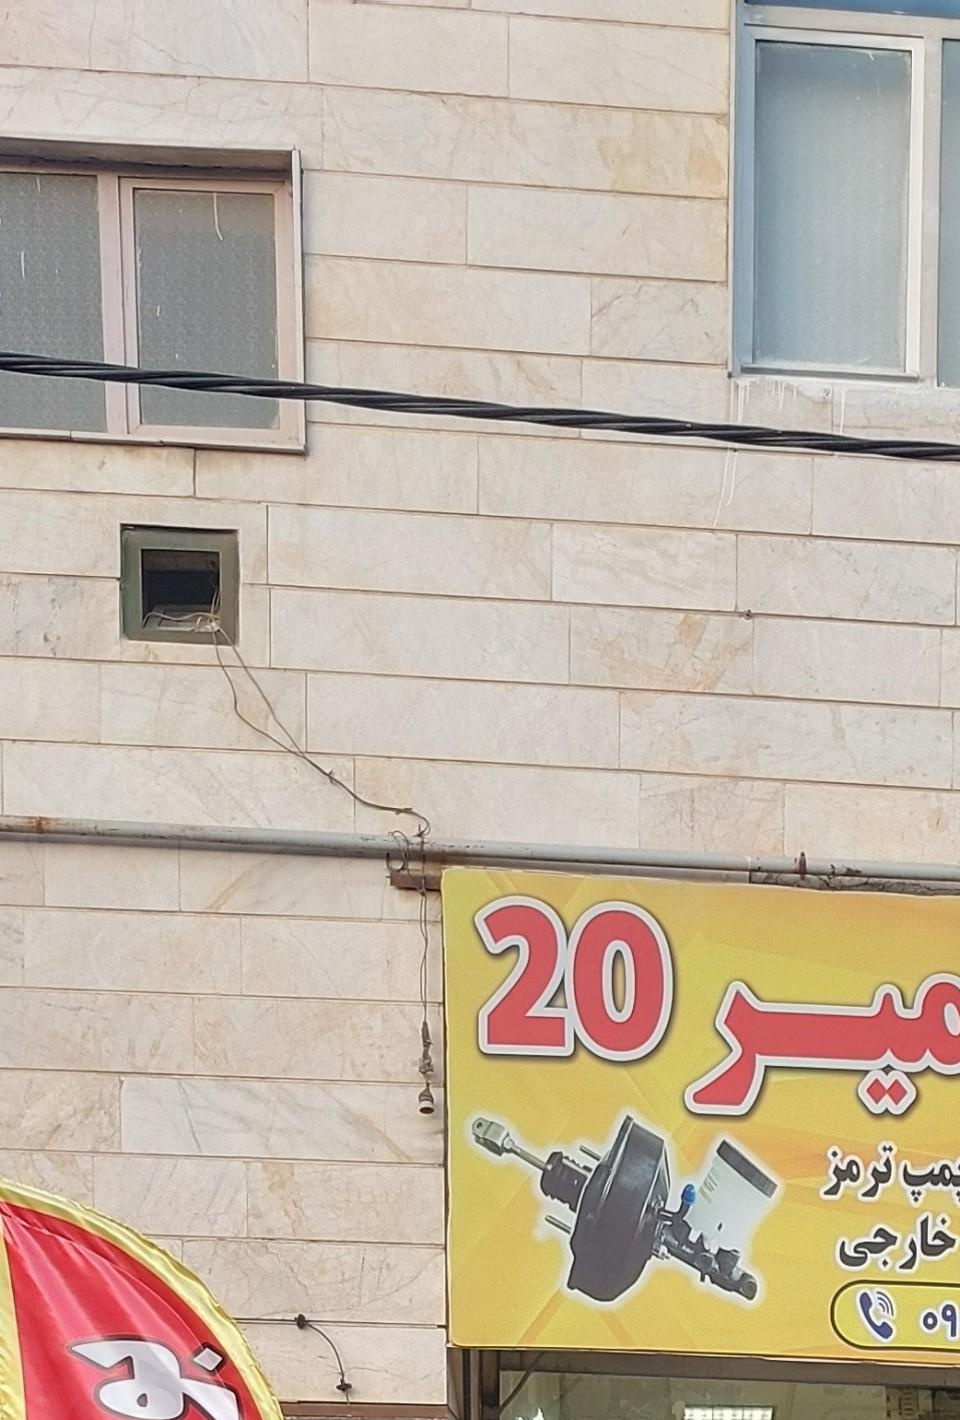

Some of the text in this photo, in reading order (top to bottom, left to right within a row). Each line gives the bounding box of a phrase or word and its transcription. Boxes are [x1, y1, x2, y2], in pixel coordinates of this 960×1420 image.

[475, 896, 674, 1061] 20
[823, 1145, 894, 1198] ترمز
[838, 1215, 956, 1270] خارجی
